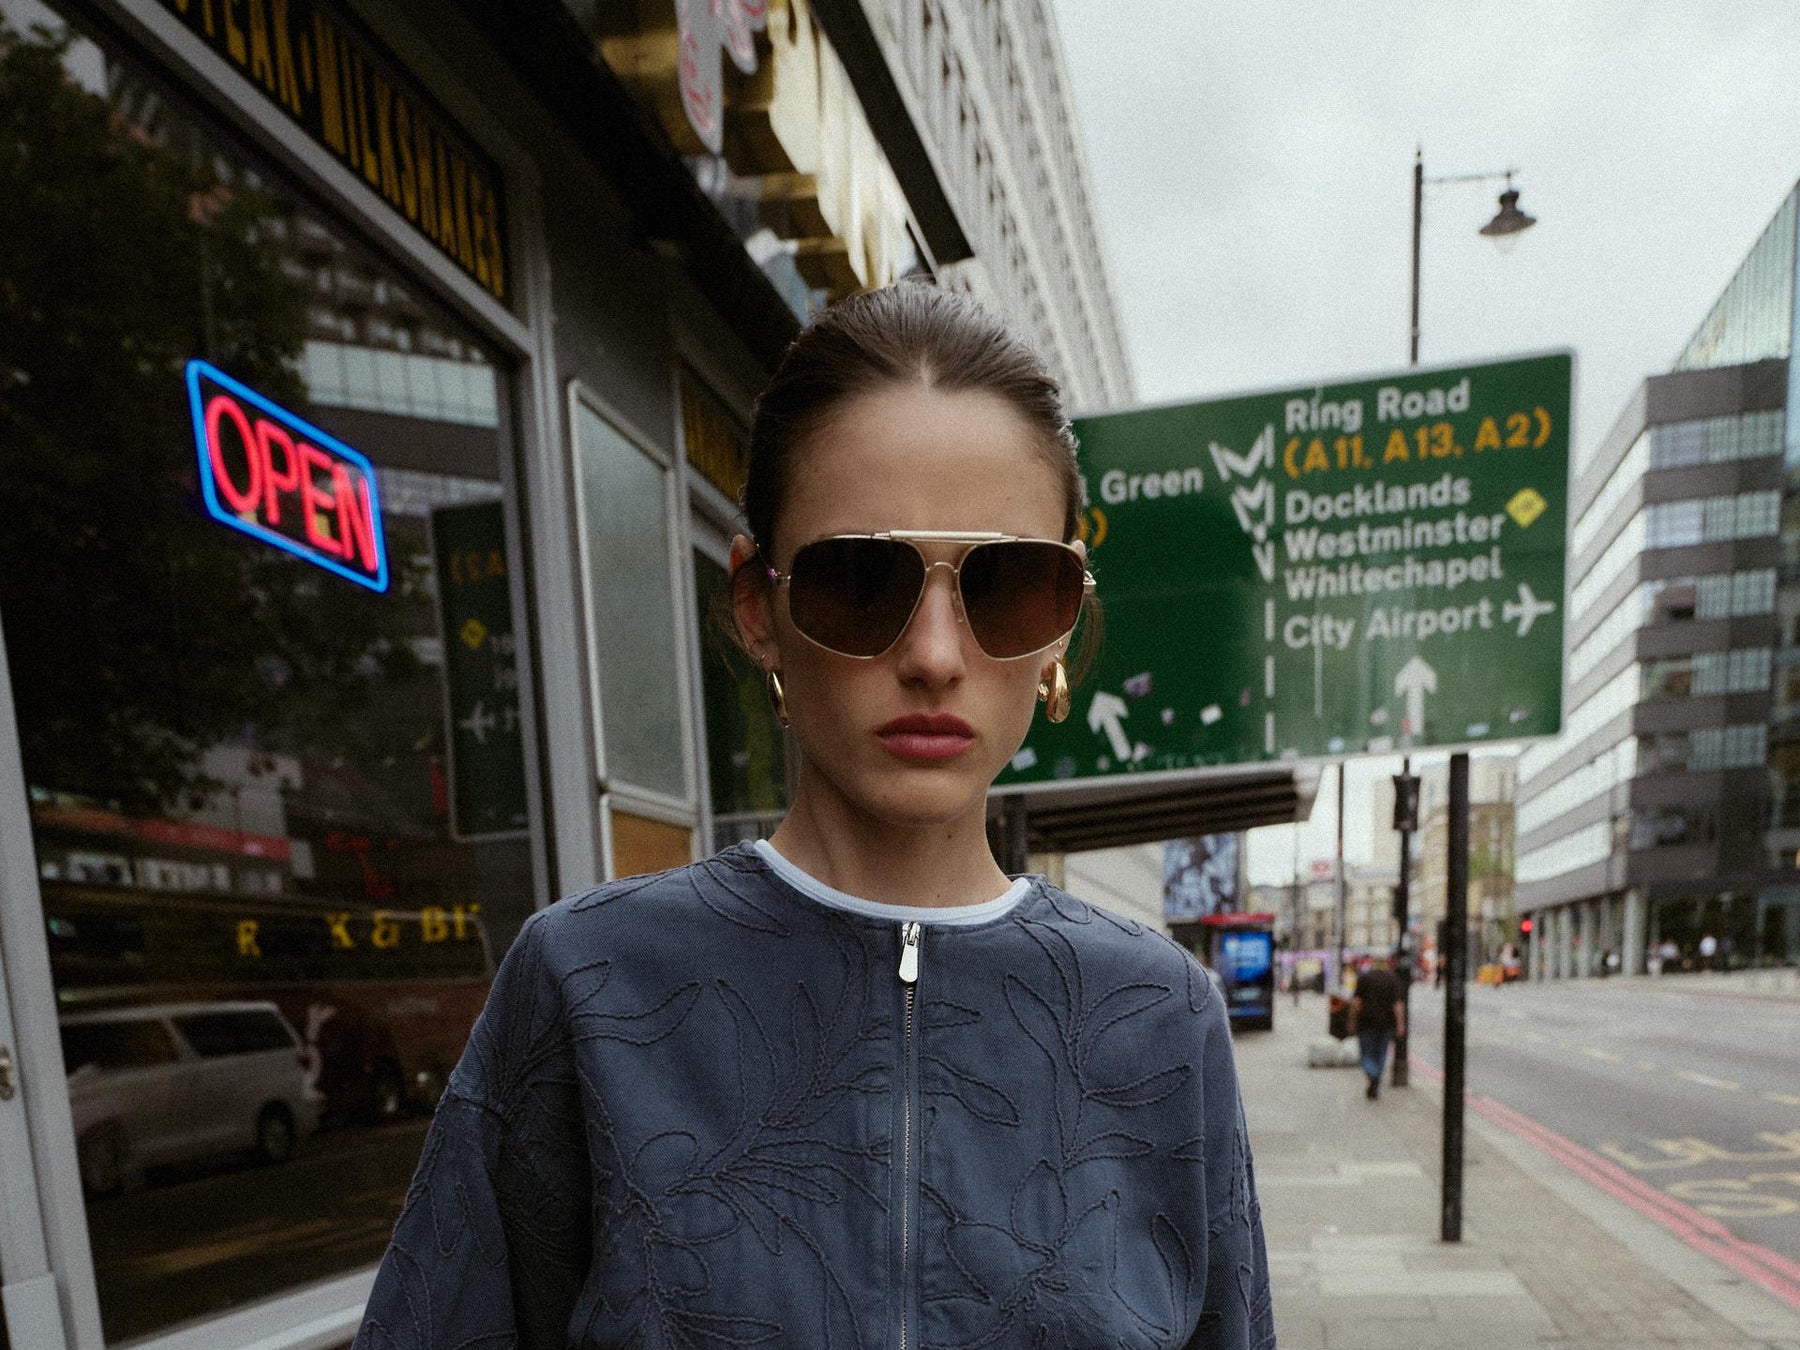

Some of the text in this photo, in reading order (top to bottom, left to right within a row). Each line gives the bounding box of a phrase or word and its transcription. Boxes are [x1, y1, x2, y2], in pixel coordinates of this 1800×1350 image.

[1285, 377, 1470, 434] Ring Road
[1474, 405, 1552, 454] A2)
[205, 394, 378, 573] OPEN
[1100, 467, 1204, 505] Green
[1285, 473, 1471, 524] Docklands
[1283, 511, 1506, 564] Westminster
[1284, 546, 1504, 601] Whitechapel
[1284, 598, 1494, 651] City Airport
